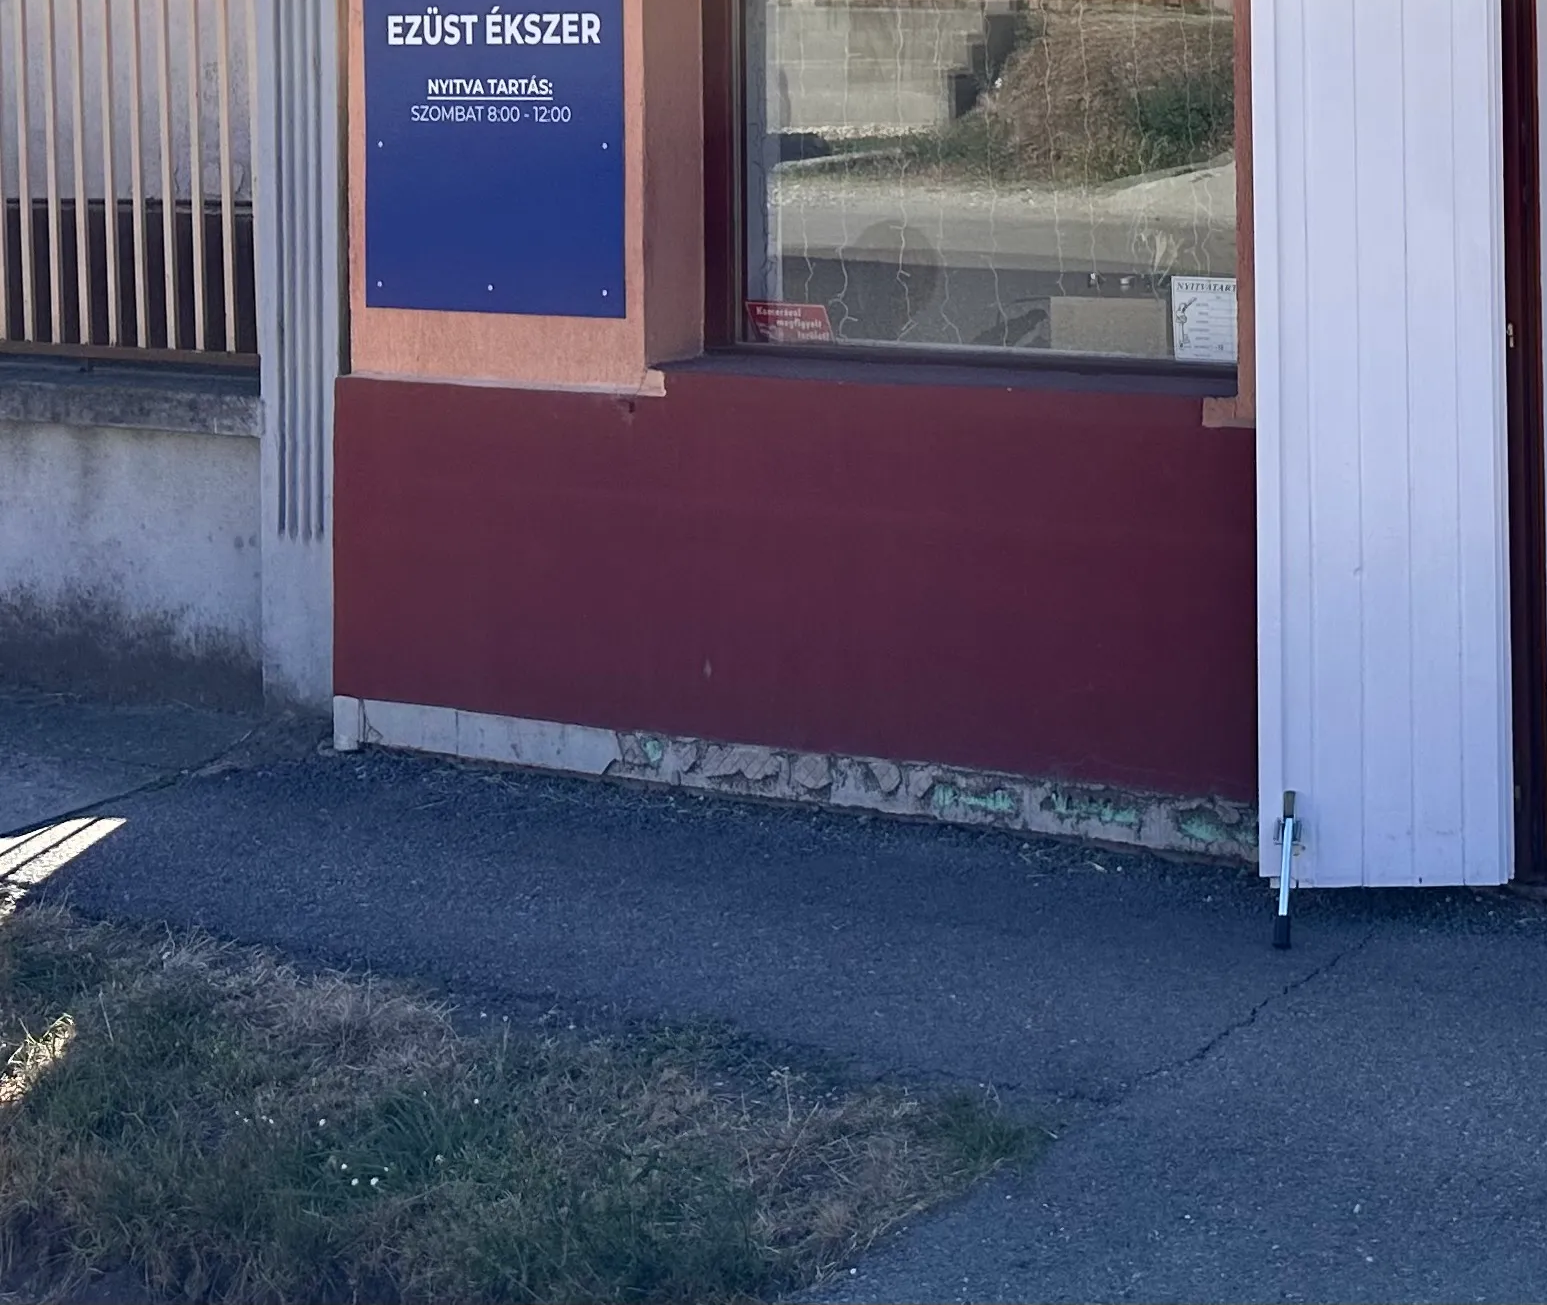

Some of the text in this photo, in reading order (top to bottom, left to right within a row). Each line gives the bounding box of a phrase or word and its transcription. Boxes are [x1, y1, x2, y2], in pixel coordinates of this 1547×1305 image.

[387, 6, 601, 45] EZÜST ÉKSZER
[427, 74, 553, 95] NYITVA TARTÁS:
[410, 106, 484, 123] SZOMBAT
[487, 106, 520, 123] 8:00
[533, 106, 572, 123] 12:00
